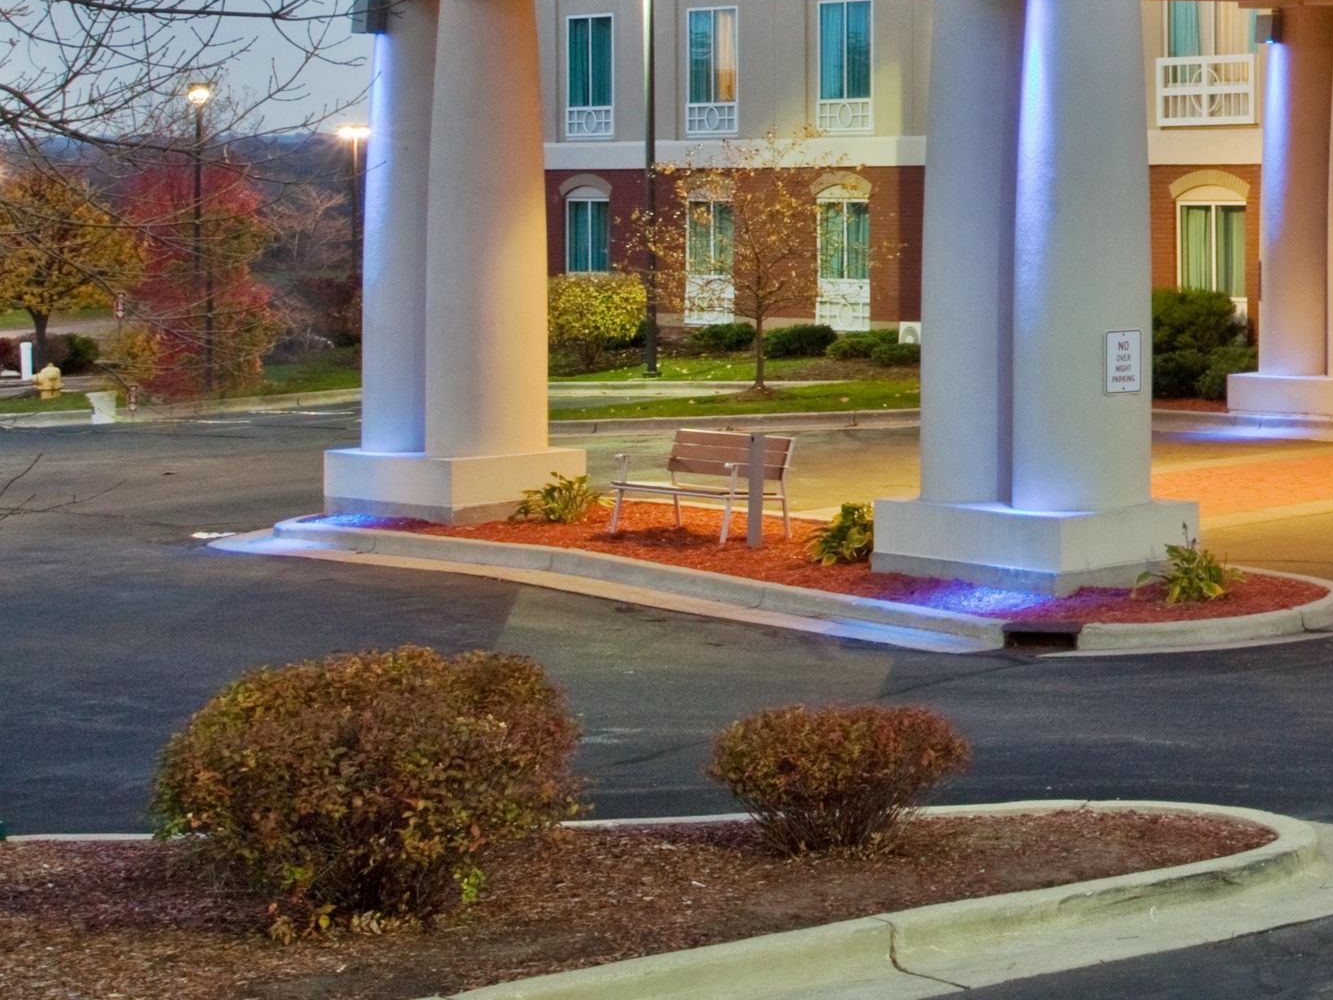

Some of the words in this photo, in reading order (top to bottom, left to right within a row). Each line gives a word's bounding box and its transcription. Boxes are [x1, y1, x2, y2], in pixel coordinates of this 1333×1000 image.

[1118, 341, 1129, 351] NO
[1116, 354, 1131, 362] OVER
[1112, 375, 1136, 383] PARKING
